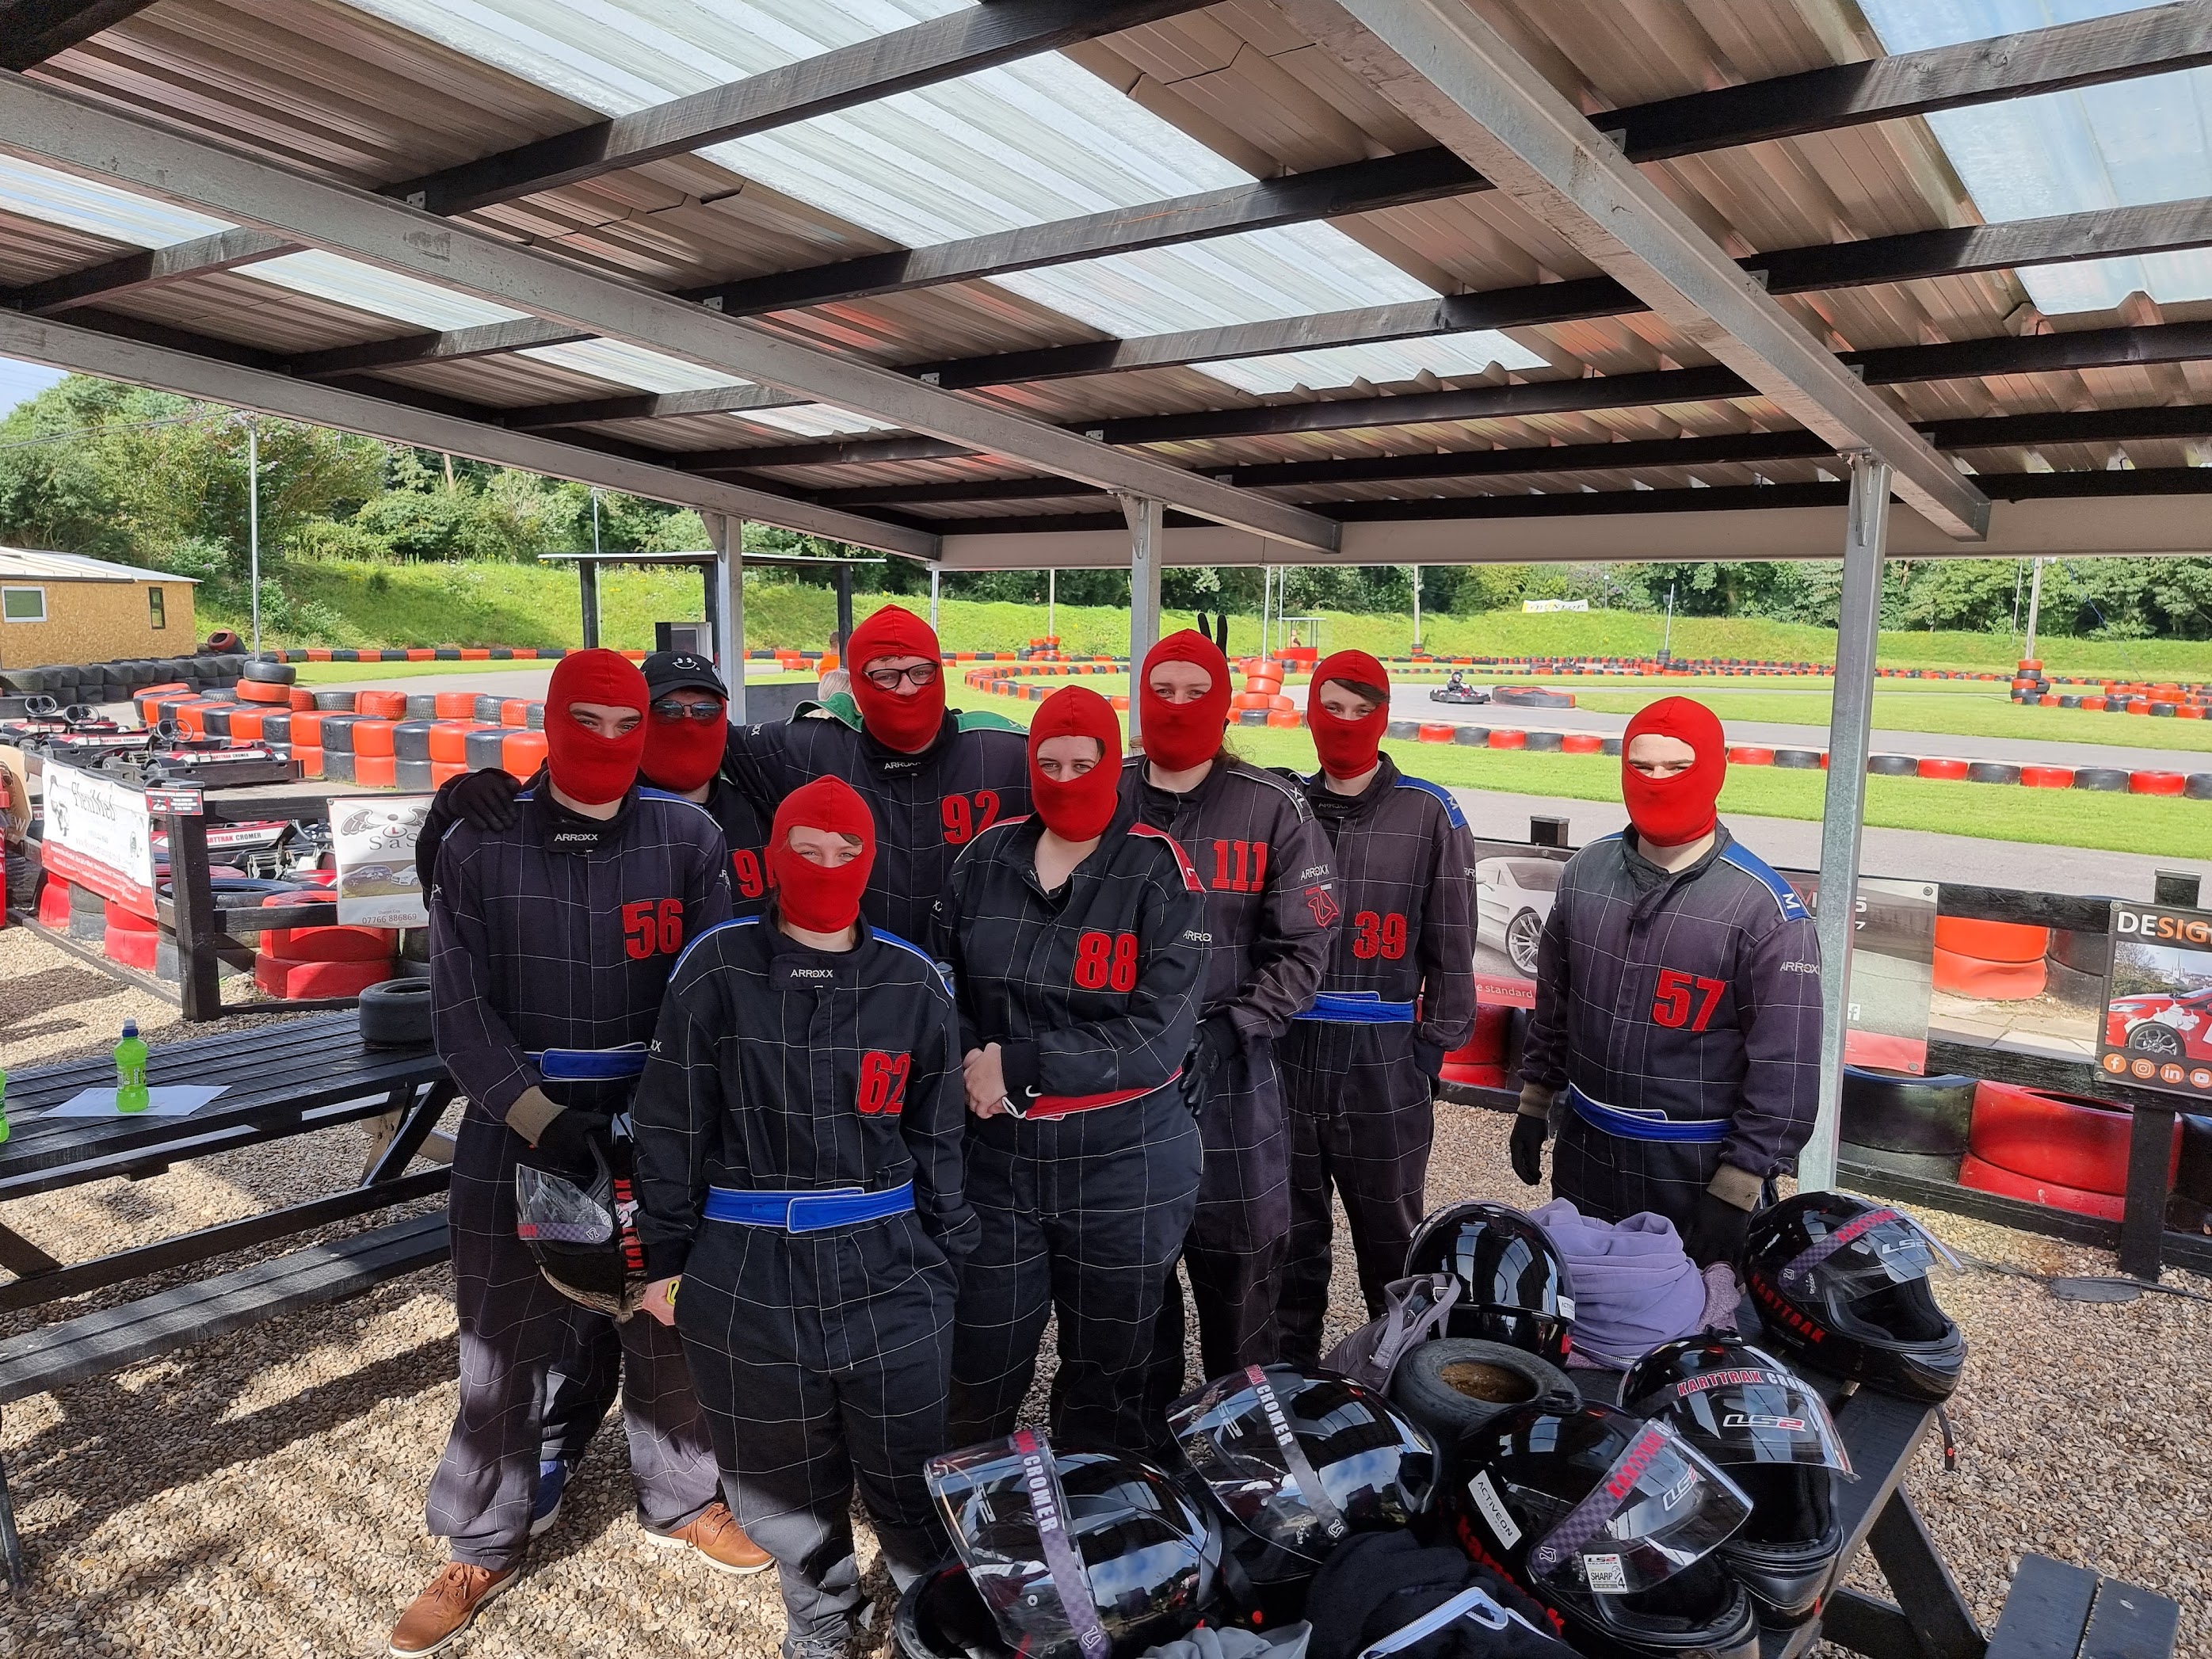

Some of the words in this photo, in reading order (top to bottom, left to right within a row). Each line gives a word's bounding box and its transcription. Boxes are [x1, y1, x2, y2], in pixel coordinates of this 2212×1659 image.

[941, 790, 1000, 845] 92
[1446, 795, 1460, 810] M
[206, 835, 234, 844] ARTTRAK
[235, 832, 261, 841] CROMER
[733, 849, 776, 898] 9
[1212, 840, 1268, 891] 111
[1300, 864, 1330, 880] ARROXX
[1782, 893, 1800, 910] M
[362, 915, 387, 925] 07766
[389, 913, 417, 922] 886869
[622, 898, 683, 959] 56
[1352, 910, 1407, 959] 39
[2117, 911, 2212, 944] DESIG
[1183, 929, 1212, 943] ARRO
[790, 969, 833, 978] ARROXX
[1074, 932, 1138, 992] 88
[1485, 984, 1533, 998] standard
[1653, 968, 1726, 1032] 57
[858, 1050, 910, 1114] 62
[1882, 1239, 1928, 1254] LS2
[1751, 1272, 1825, 1344] KARTTRAK
[1676, 1370, 1764, 1397] KARTTRAK
[1766, 1371, 1821, 1402] CROMER
[1256, 1384, 1294, 1447] CROMER
[1722, 1413, 1807, 1432] LS2
[1023, 1454, 1058, 1533] CROMER
[1662, 1463, 1698, 1512] LS2
[1477, 1481, 1513, 1537] ACTIVEON
[1590, 1572, 1613, 1581] SHARP
[1618, 1577, 1626, 1589] 4
